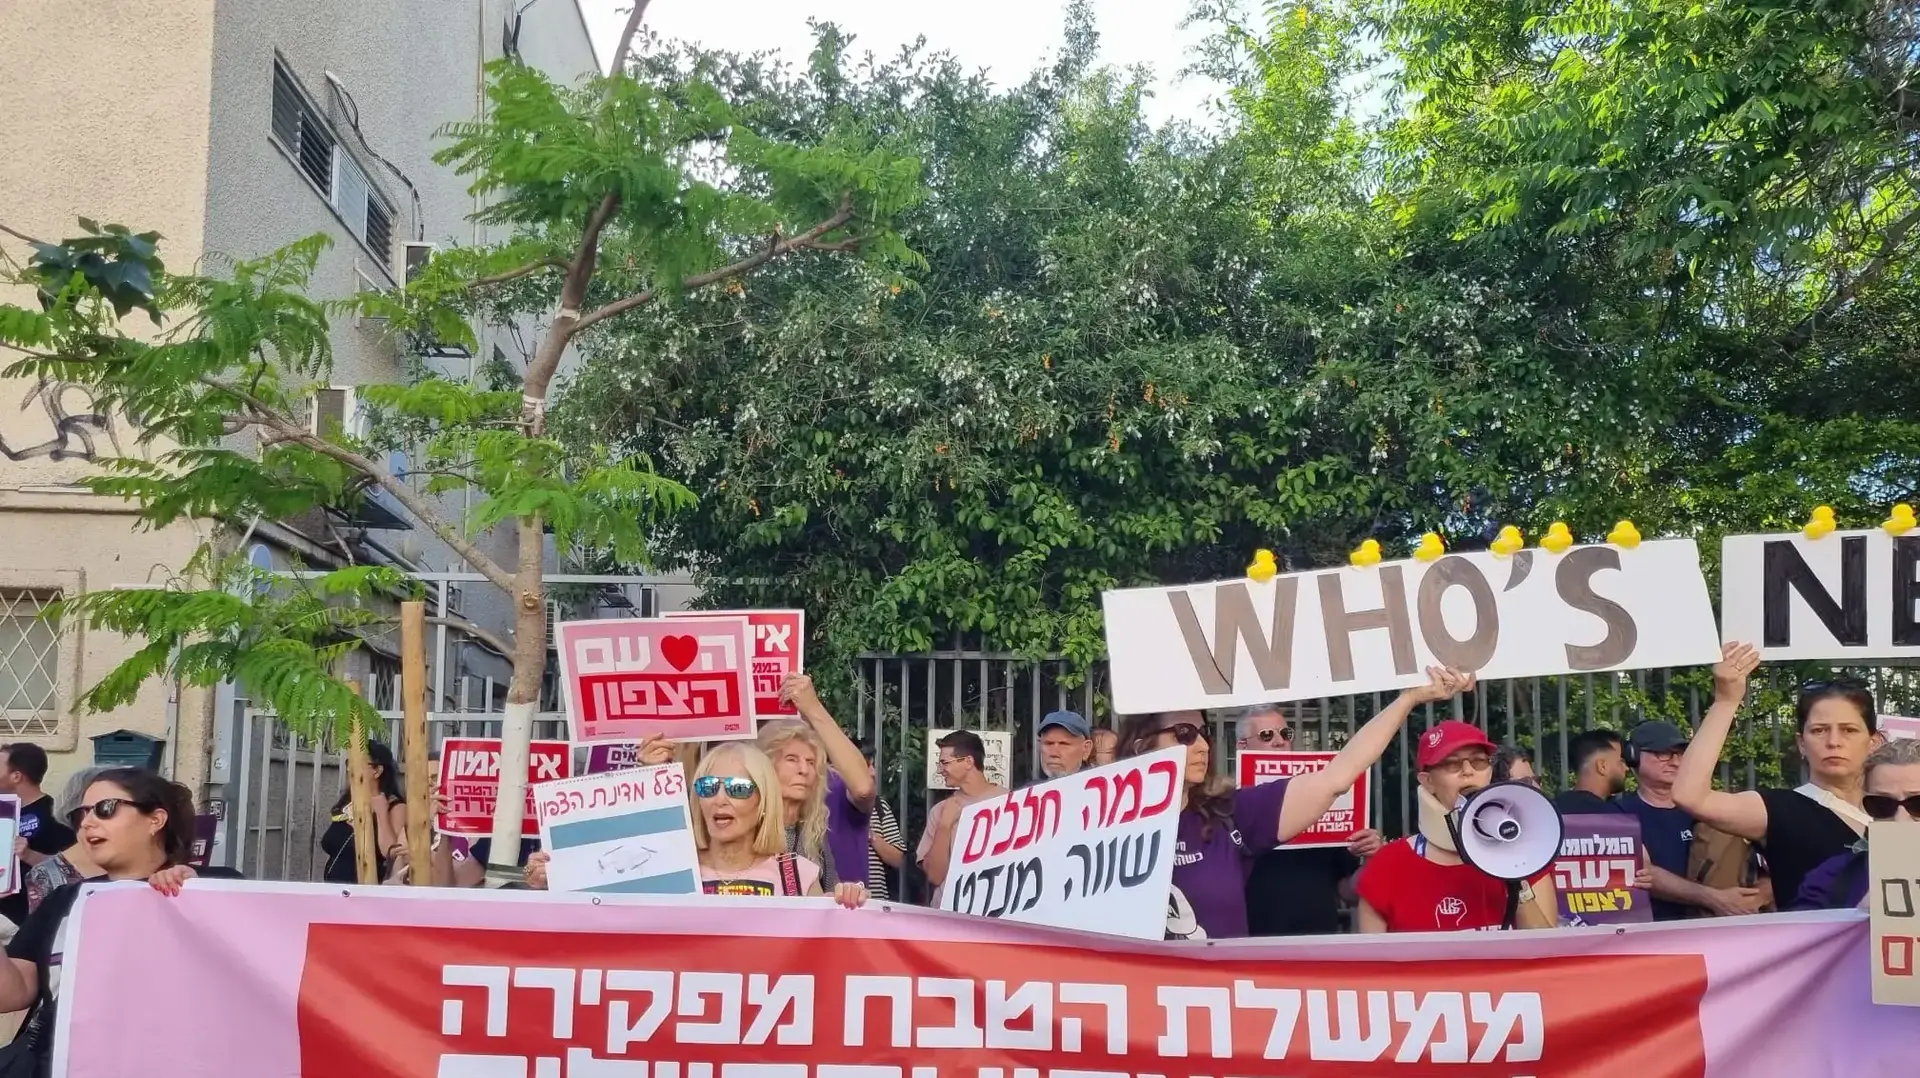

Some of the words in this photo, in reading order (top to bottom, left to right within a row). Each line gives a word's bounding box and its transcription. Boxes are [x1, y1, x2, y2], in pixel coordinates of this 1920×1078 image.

[1167, 546, 1638, 695] WHO'S
[573, 636, 652, 674] עם
[592, 679, 729, 721] הצפון
[530, 753, 562, 779] אי
[588, 780, 646, 809] מדינת
[1081, 760, 1178, 831] כמה
[539, 791, 585, 827] הצפון
[961, 786, 1062, 865] חללים
[952, 856, 1043, 918] מנדט
[1063, 829, 1162, 903] שווה
[1554, 859, 1636, 889] רעה
[1566, 888, 1633, 914] לצפון
[442, 964, 815, 1055] מפקירה
[843, 975, 1128, 1056] הטבח
[1156, 979, 1545, 1064] ממשלת
